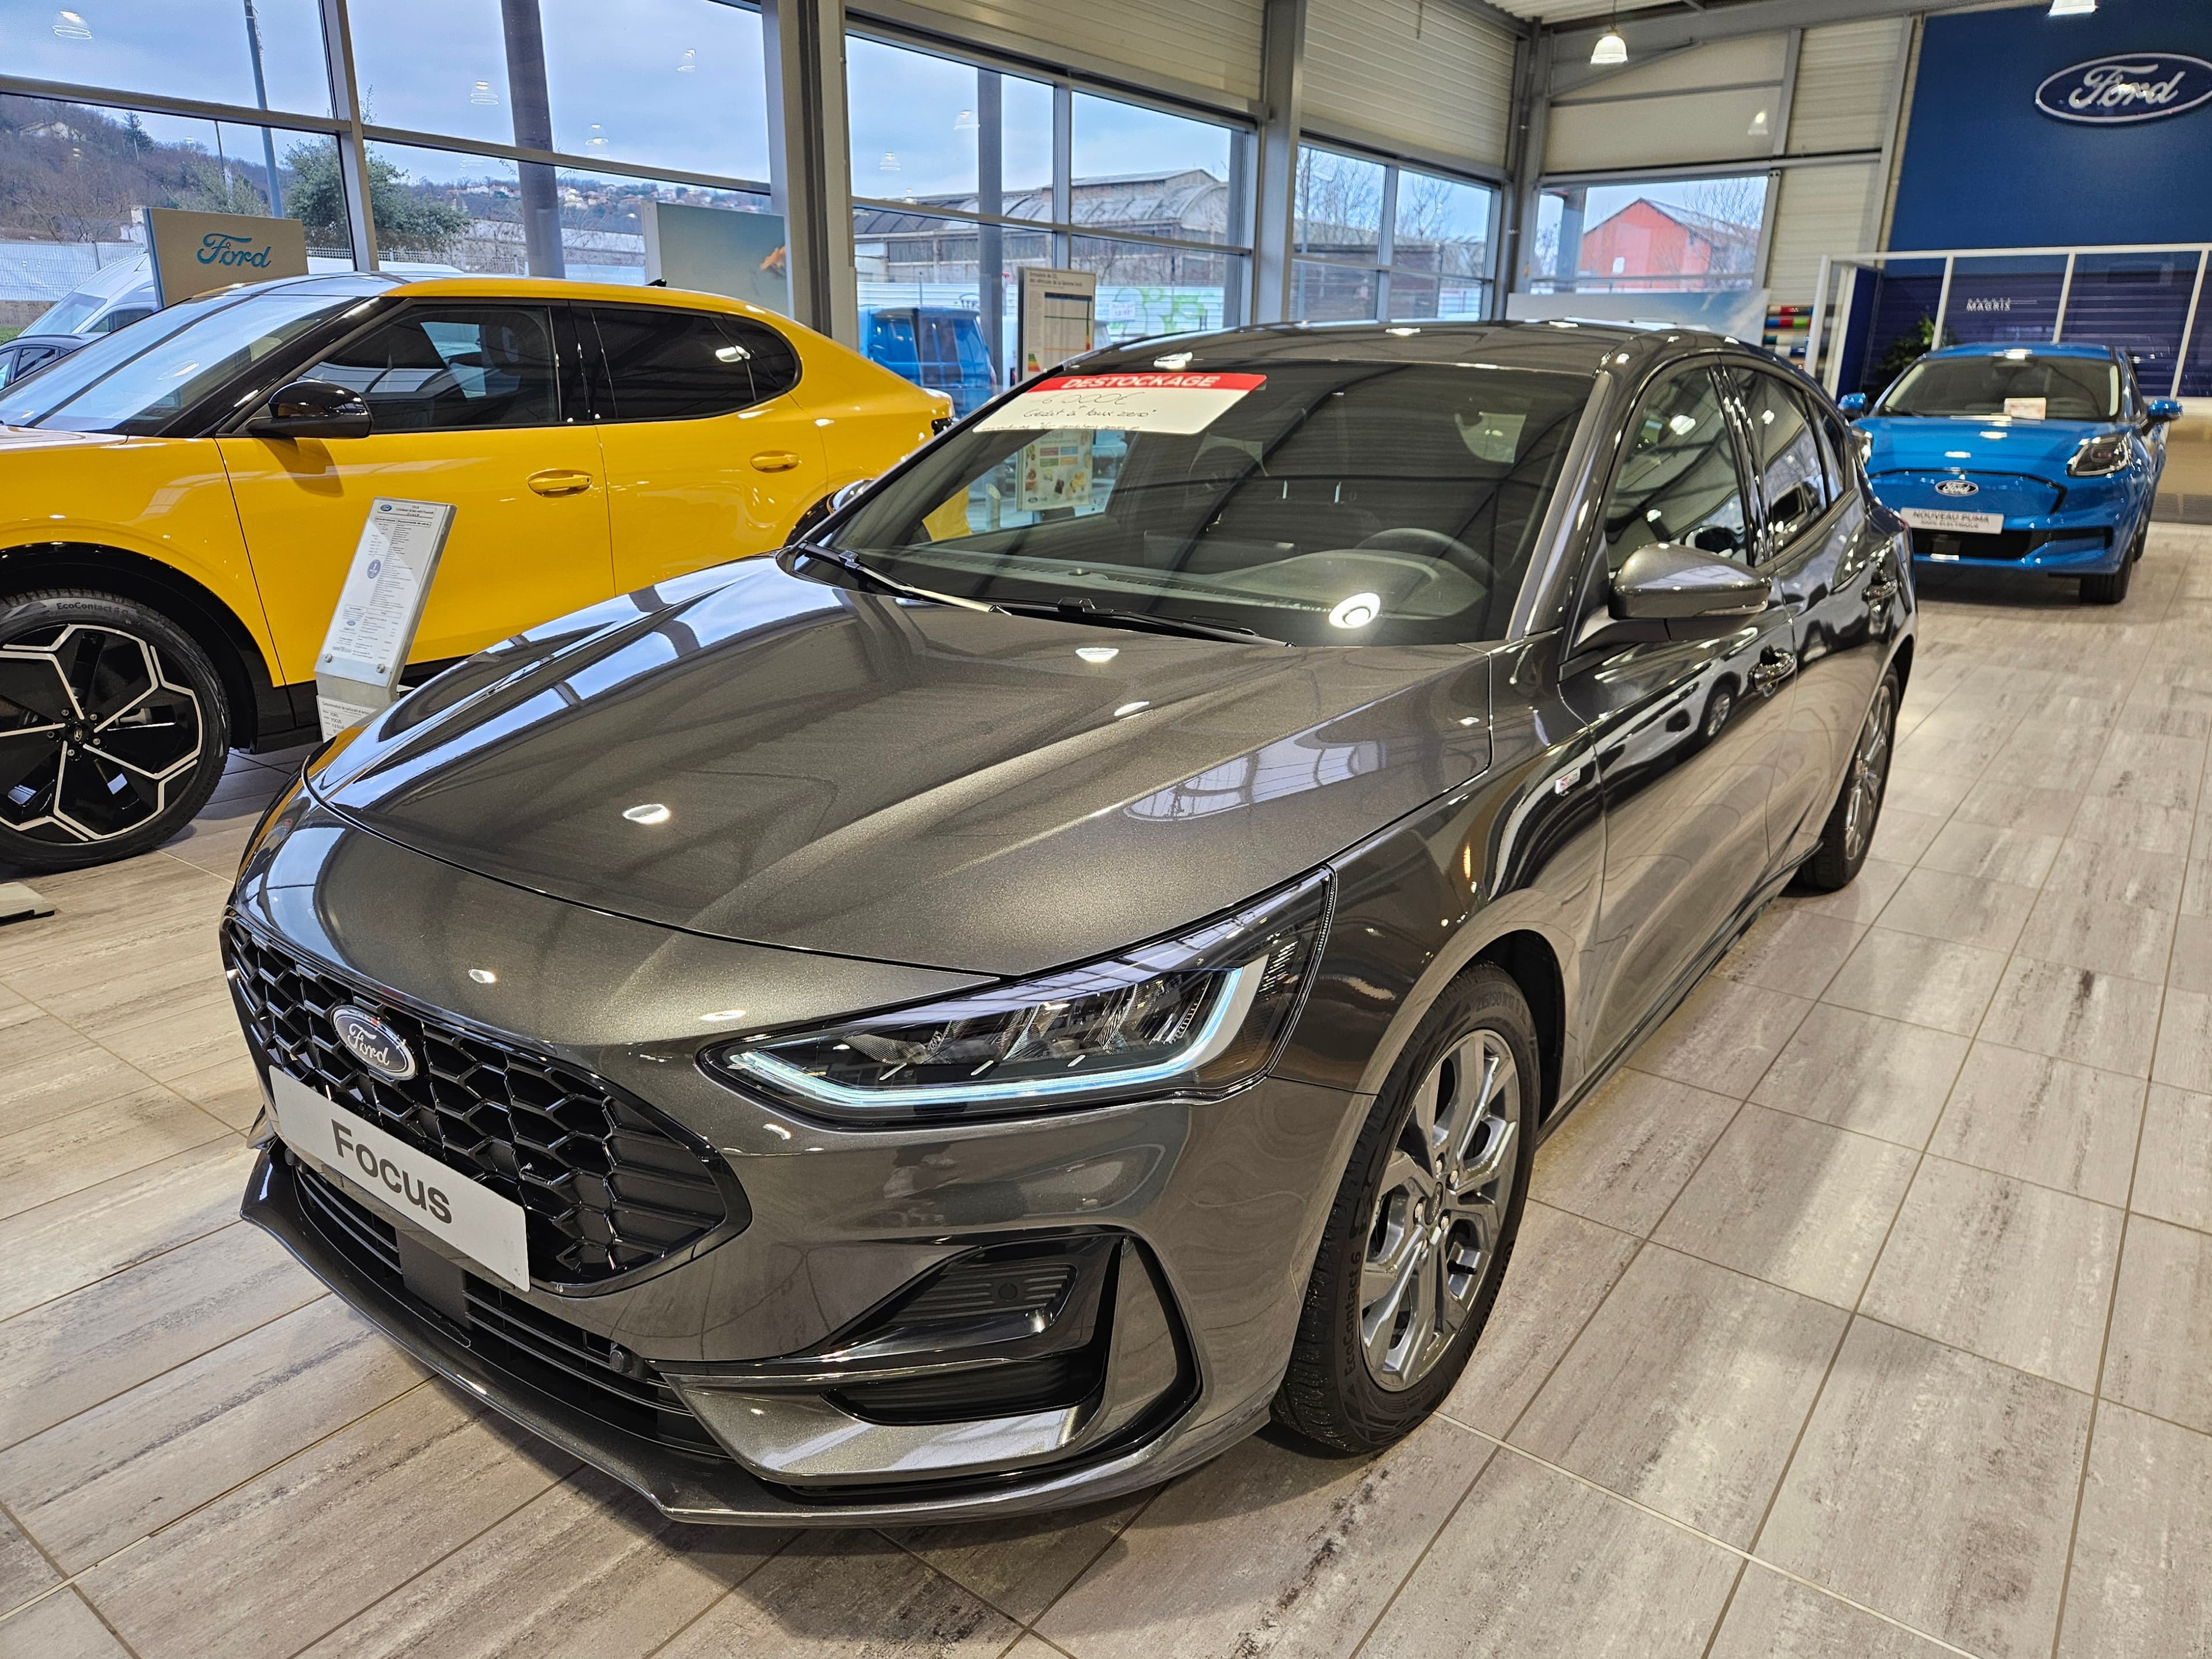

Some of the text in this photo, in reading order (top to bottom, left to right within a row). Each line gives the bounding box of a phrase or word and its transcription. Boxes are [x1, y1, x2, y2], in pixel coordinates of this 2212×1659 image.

[2068, 63, 2186, 109] Ford
[197, 233, 271, 269] Ford
[1966, 301, 2011, 312] MAGRIS
[1060, 375, 1221, 389] DESTOCKAGE
[1943, 482, 1971, 494] Ford
[1913, 511, 1990, 524] NOUVEAU PUMA
[56, 602, 112, 613] EcoContact
[346, 1023, 391, 1066] Ford
[1342, 1250, 1362, 1378] EcoContact 6
